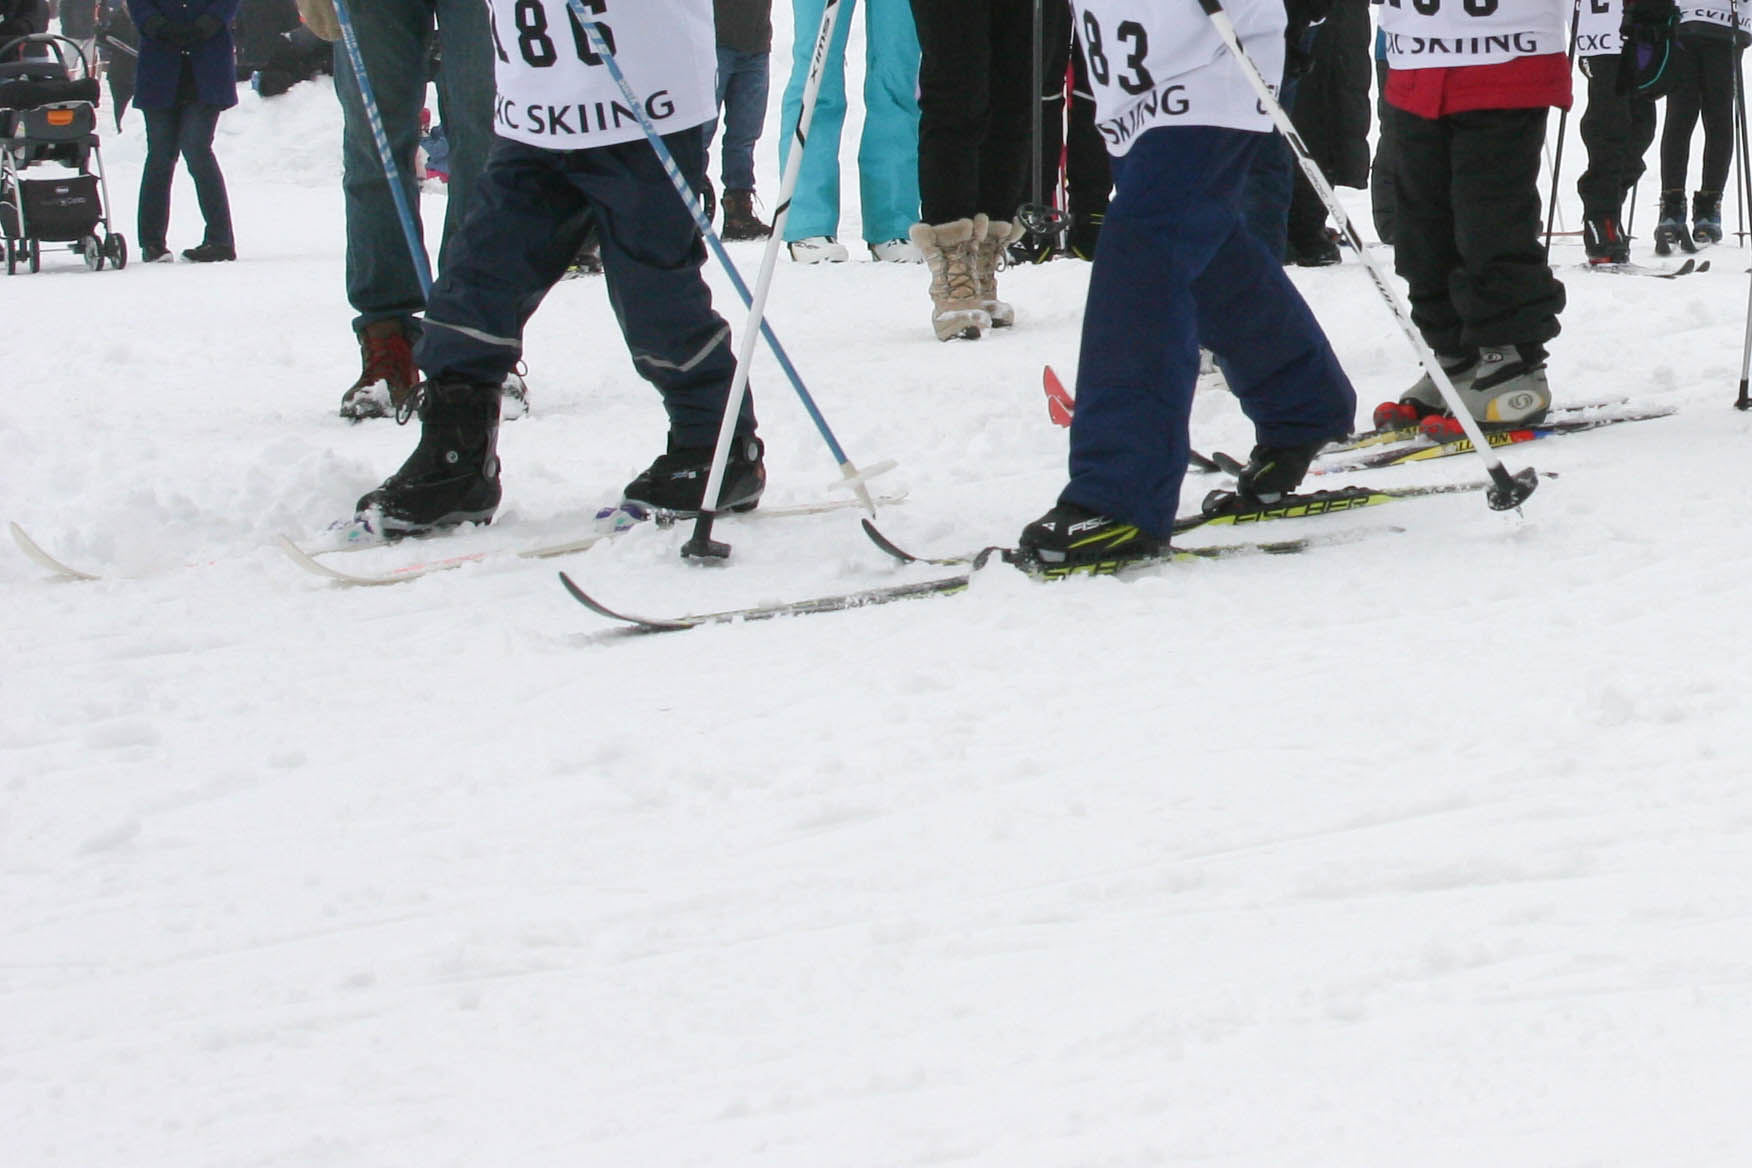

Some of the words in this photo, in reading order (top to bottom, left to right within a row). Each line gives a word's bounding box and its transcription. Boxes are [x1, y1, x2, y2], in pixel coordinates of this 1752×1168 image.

[1577, 33, 1612, 51] CXC
[527, 90, 676, 135] SKIING
[1234, 496, 1369, 525] FISCHER
